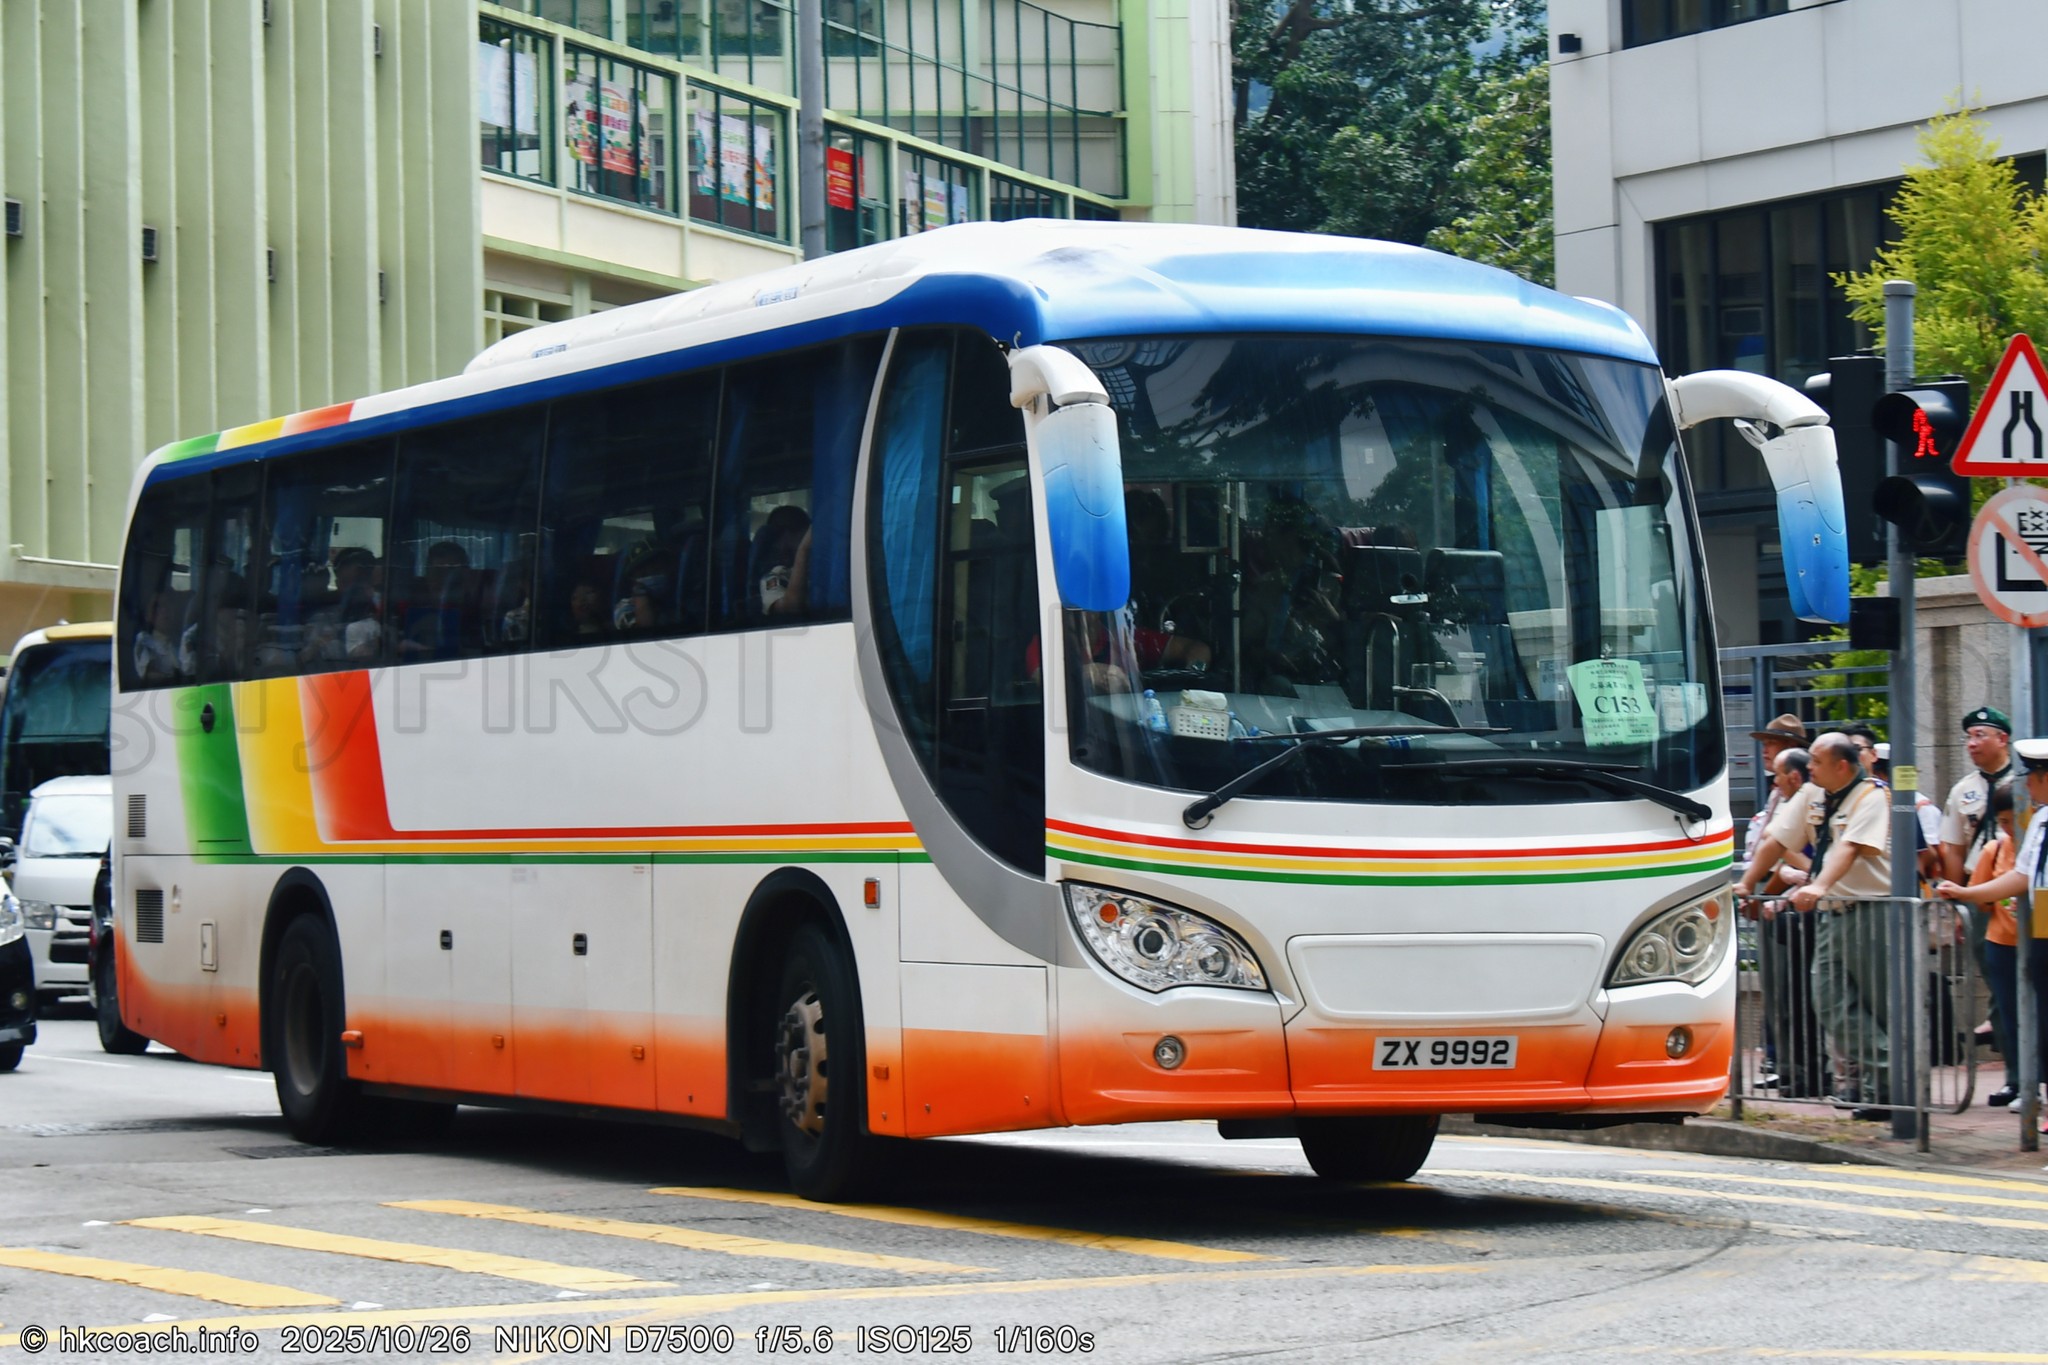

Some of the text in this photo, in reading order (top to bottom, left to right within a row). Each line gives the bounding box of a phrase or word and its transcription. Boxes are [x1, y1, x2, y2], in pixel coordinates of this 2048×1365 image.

[1594, 695, 1641, 714] C153
[1381, 1039, 1510, 1066] ZX 9992
